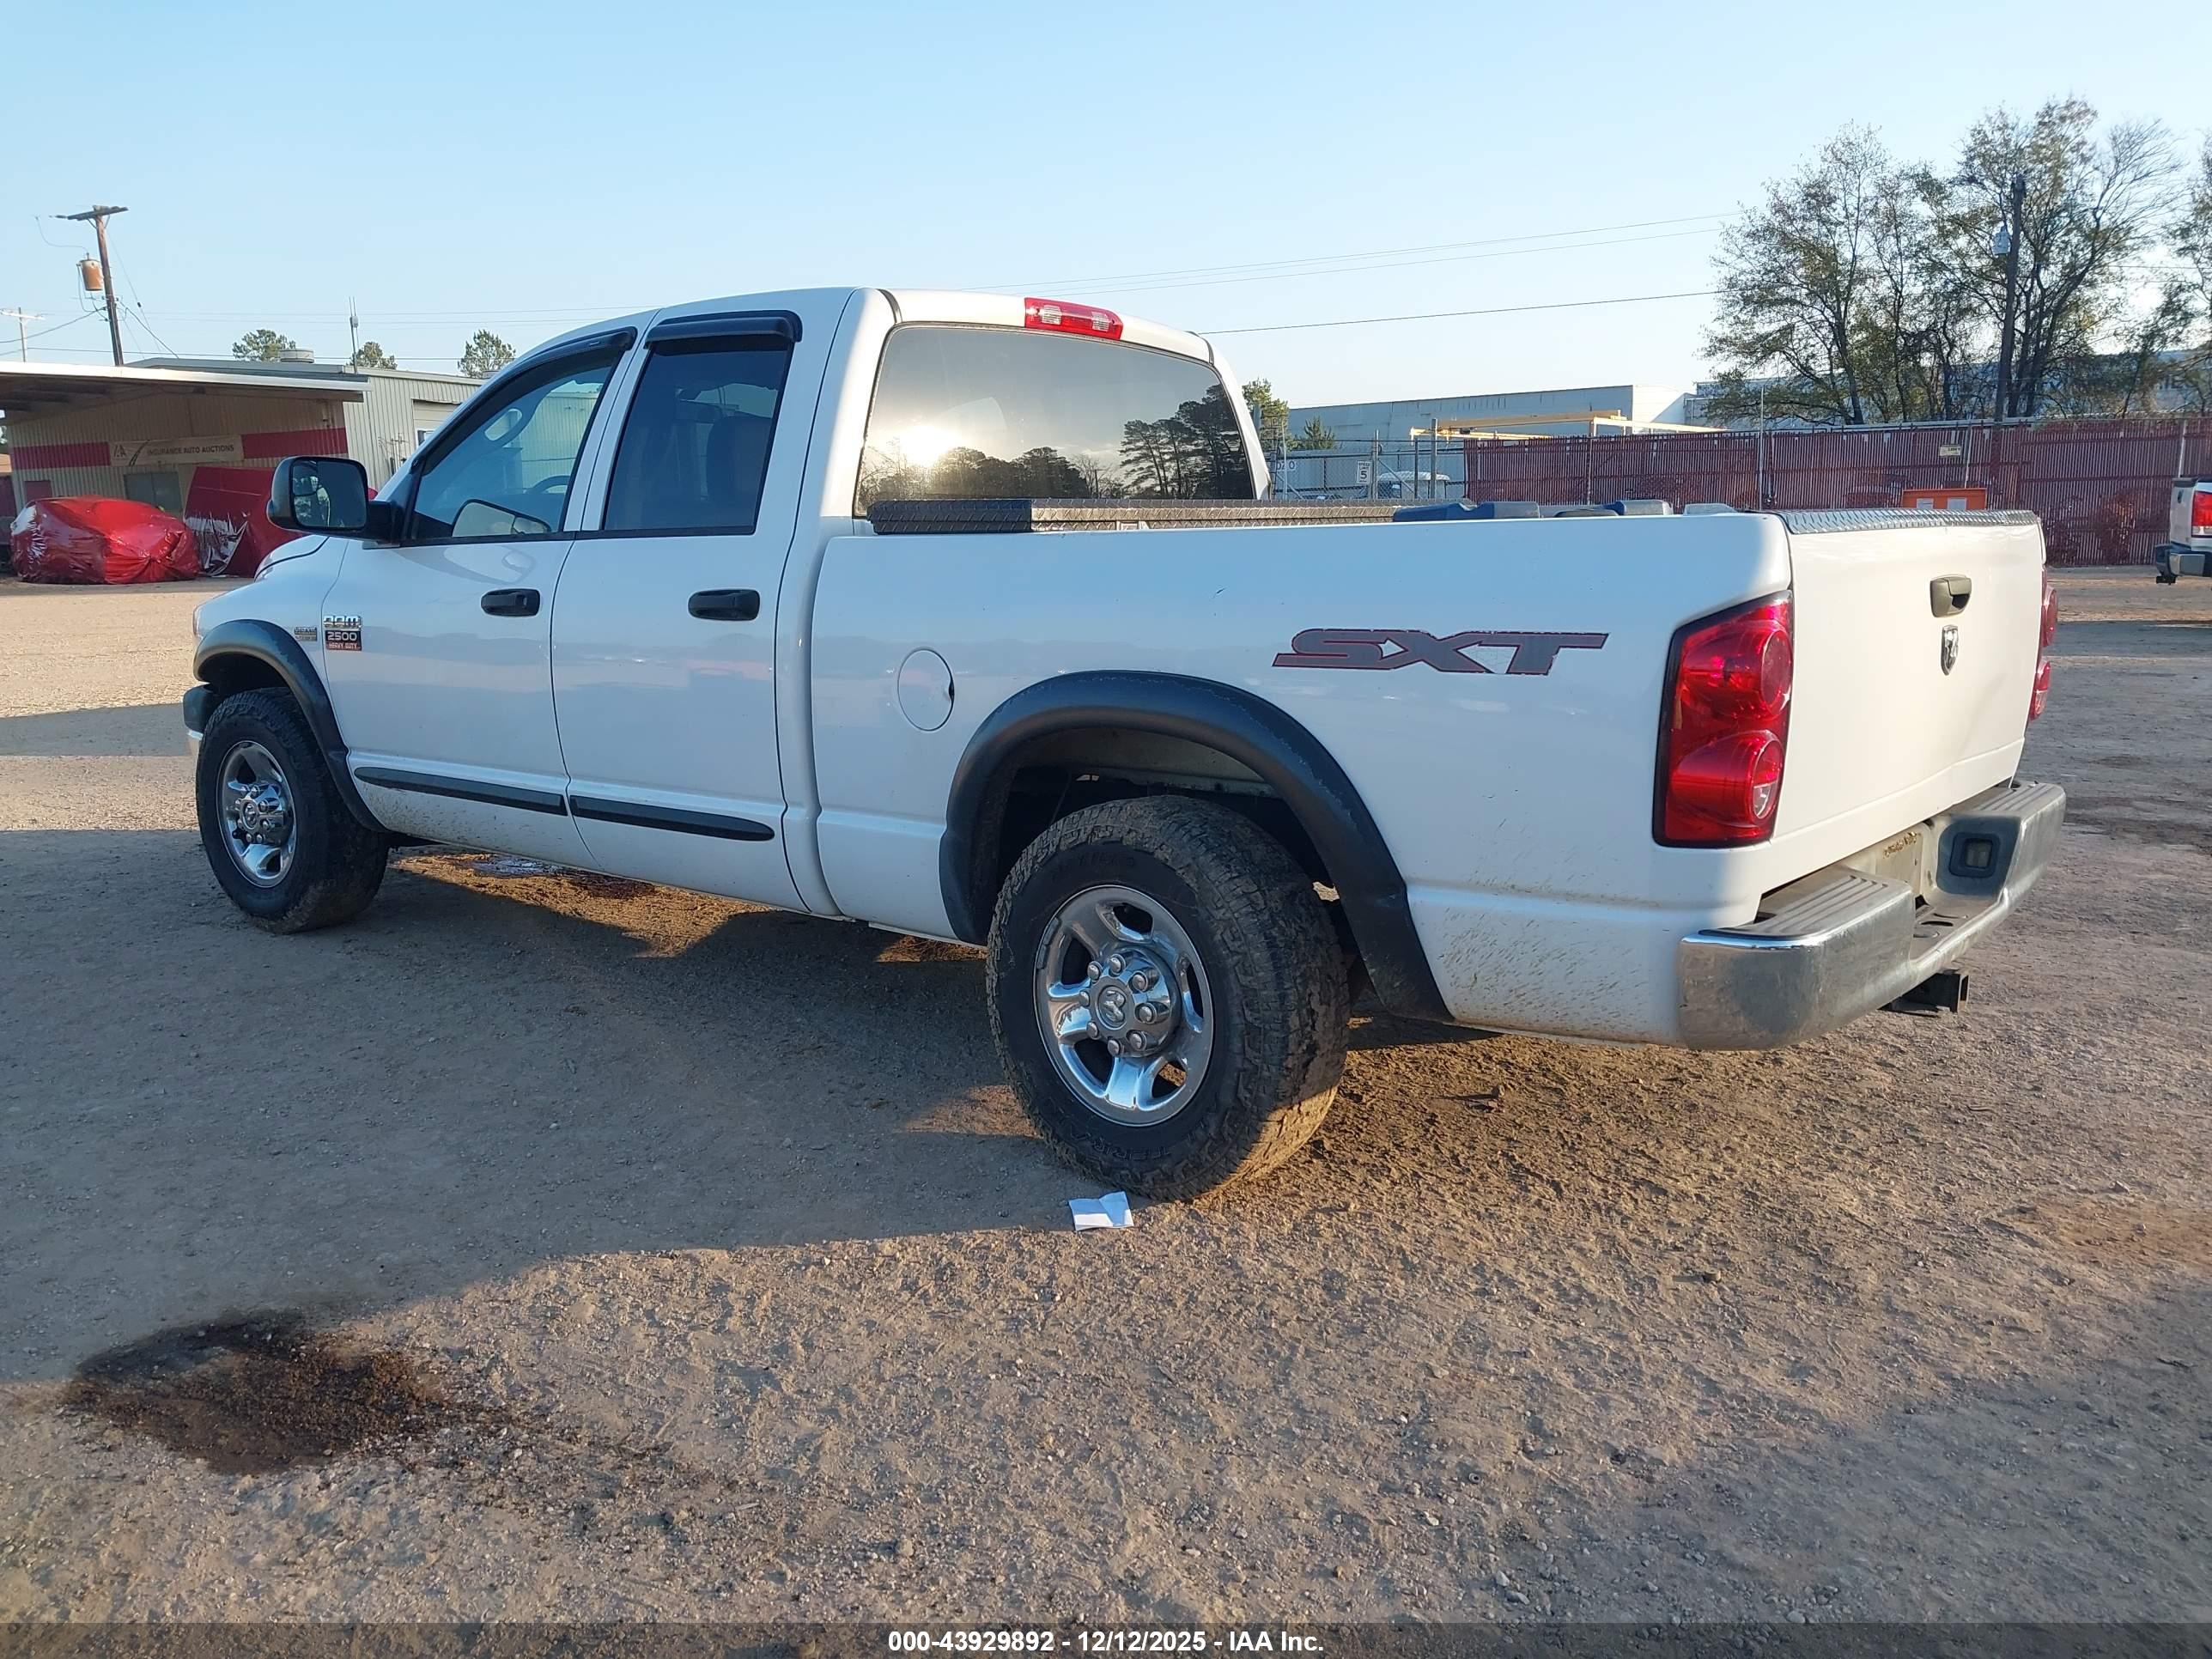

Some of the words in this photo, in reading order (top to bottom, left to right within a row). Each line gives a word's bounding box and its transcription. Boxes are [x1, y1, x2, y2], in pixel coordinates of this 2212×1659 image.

[202, 444, 234, 453] AUCTIONS
[1360, 471, 1368, 479] 5
[327, 632, 357, 641] 2500
[1272, 628, 1610, 676] SXT
